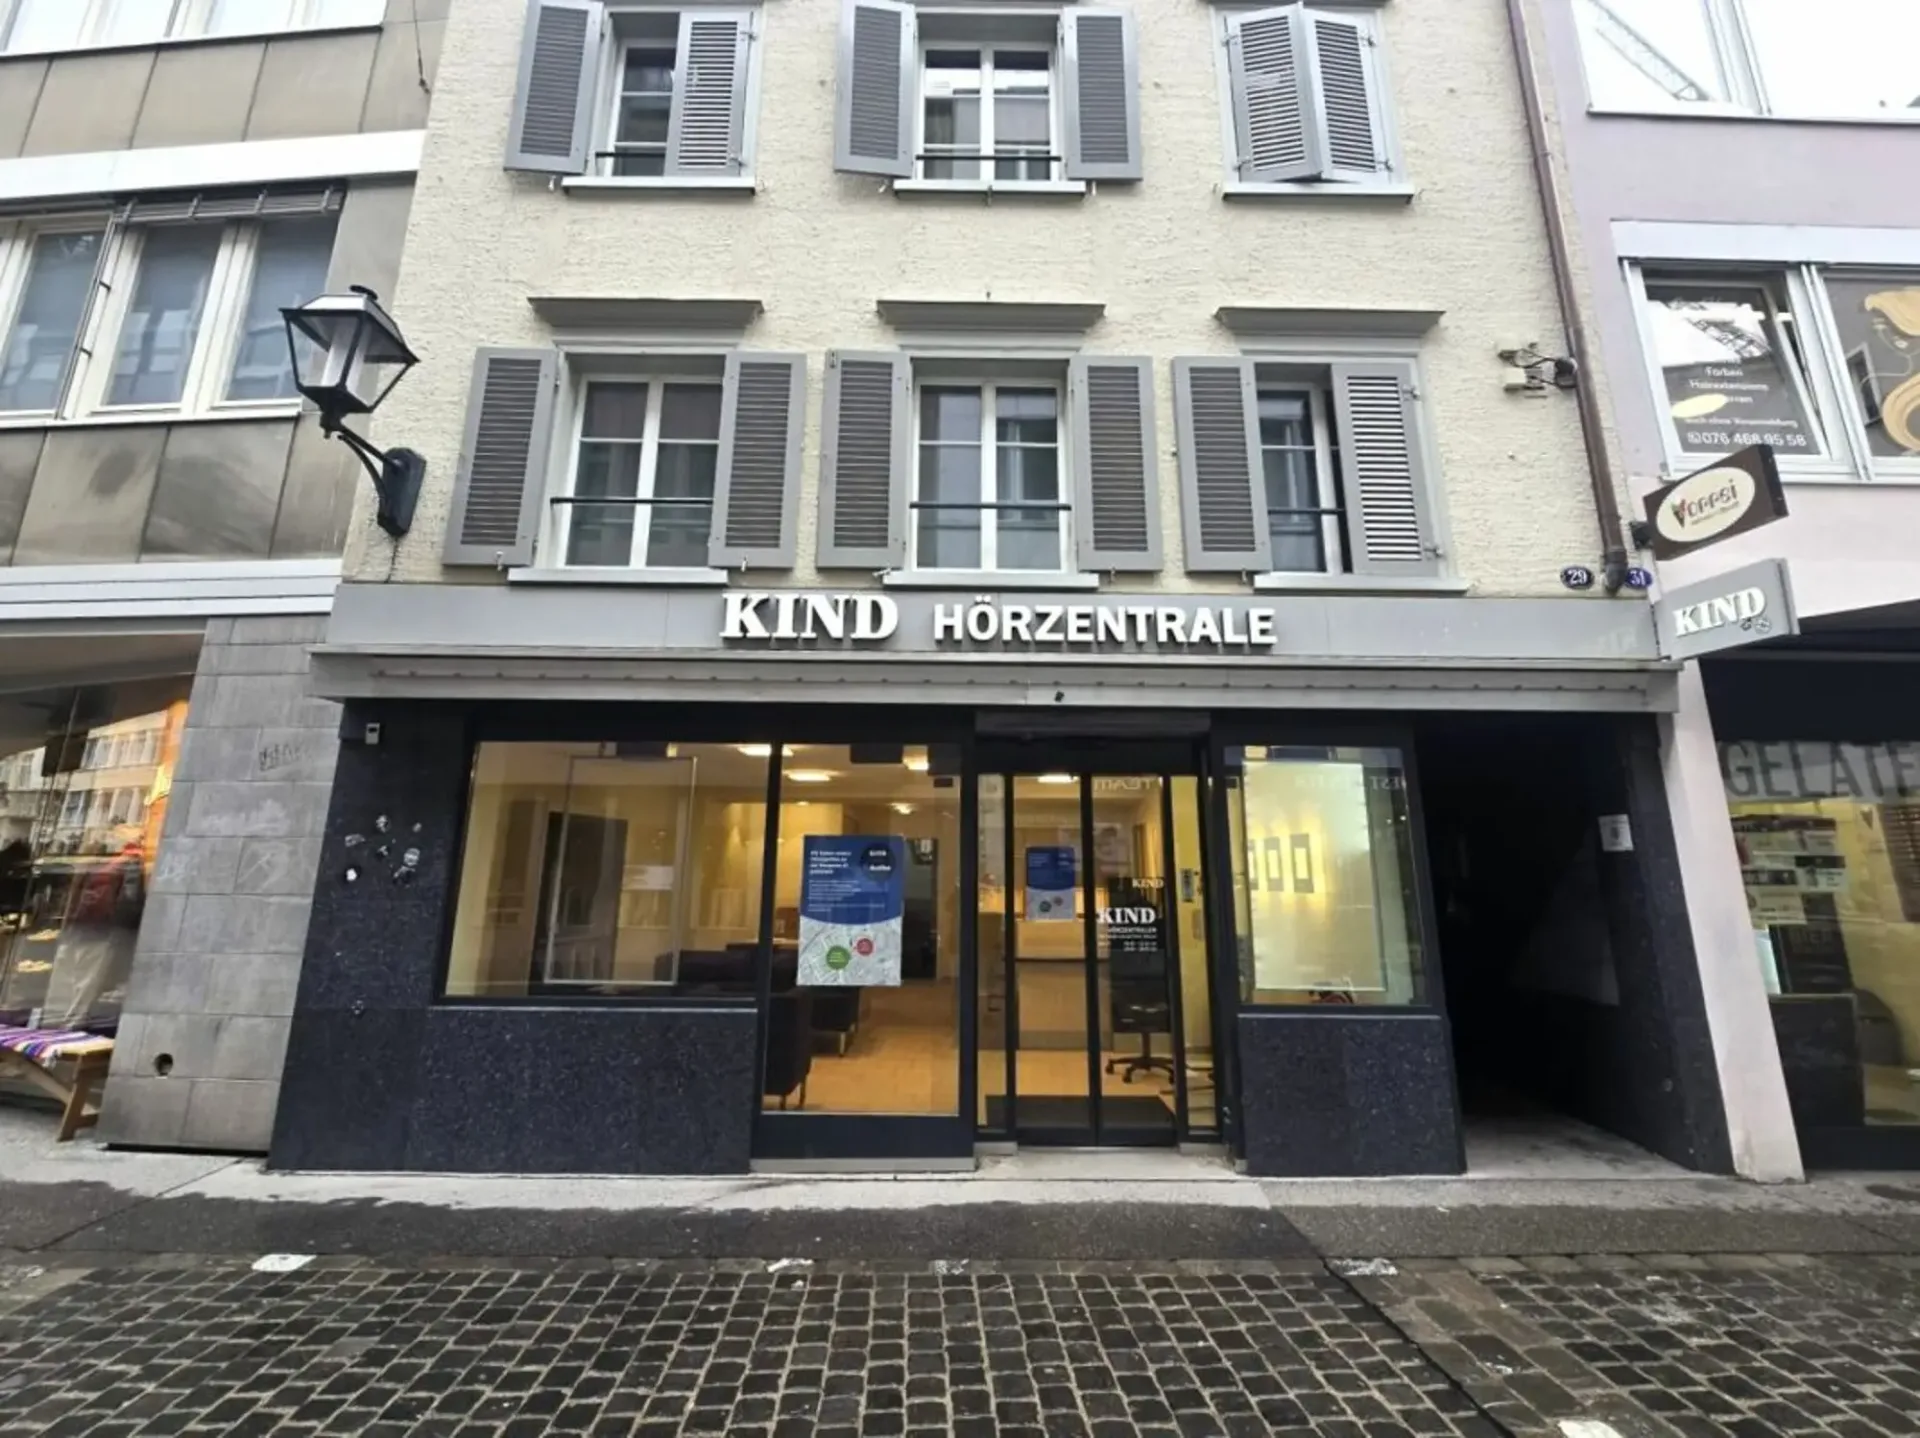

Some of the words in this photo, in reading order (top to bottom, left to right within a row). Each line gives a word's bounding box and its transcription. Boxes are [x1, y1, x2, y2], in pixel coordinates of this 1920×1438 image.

[1630, 569, 1646, 586] 31
[720, 592, 899, 640] KIND
[933, 595, 1277, 645] HÖRZENTRALE
[1672, 586, 1766, 637] KIND
[1096, 907, 1156, 924] KIND
